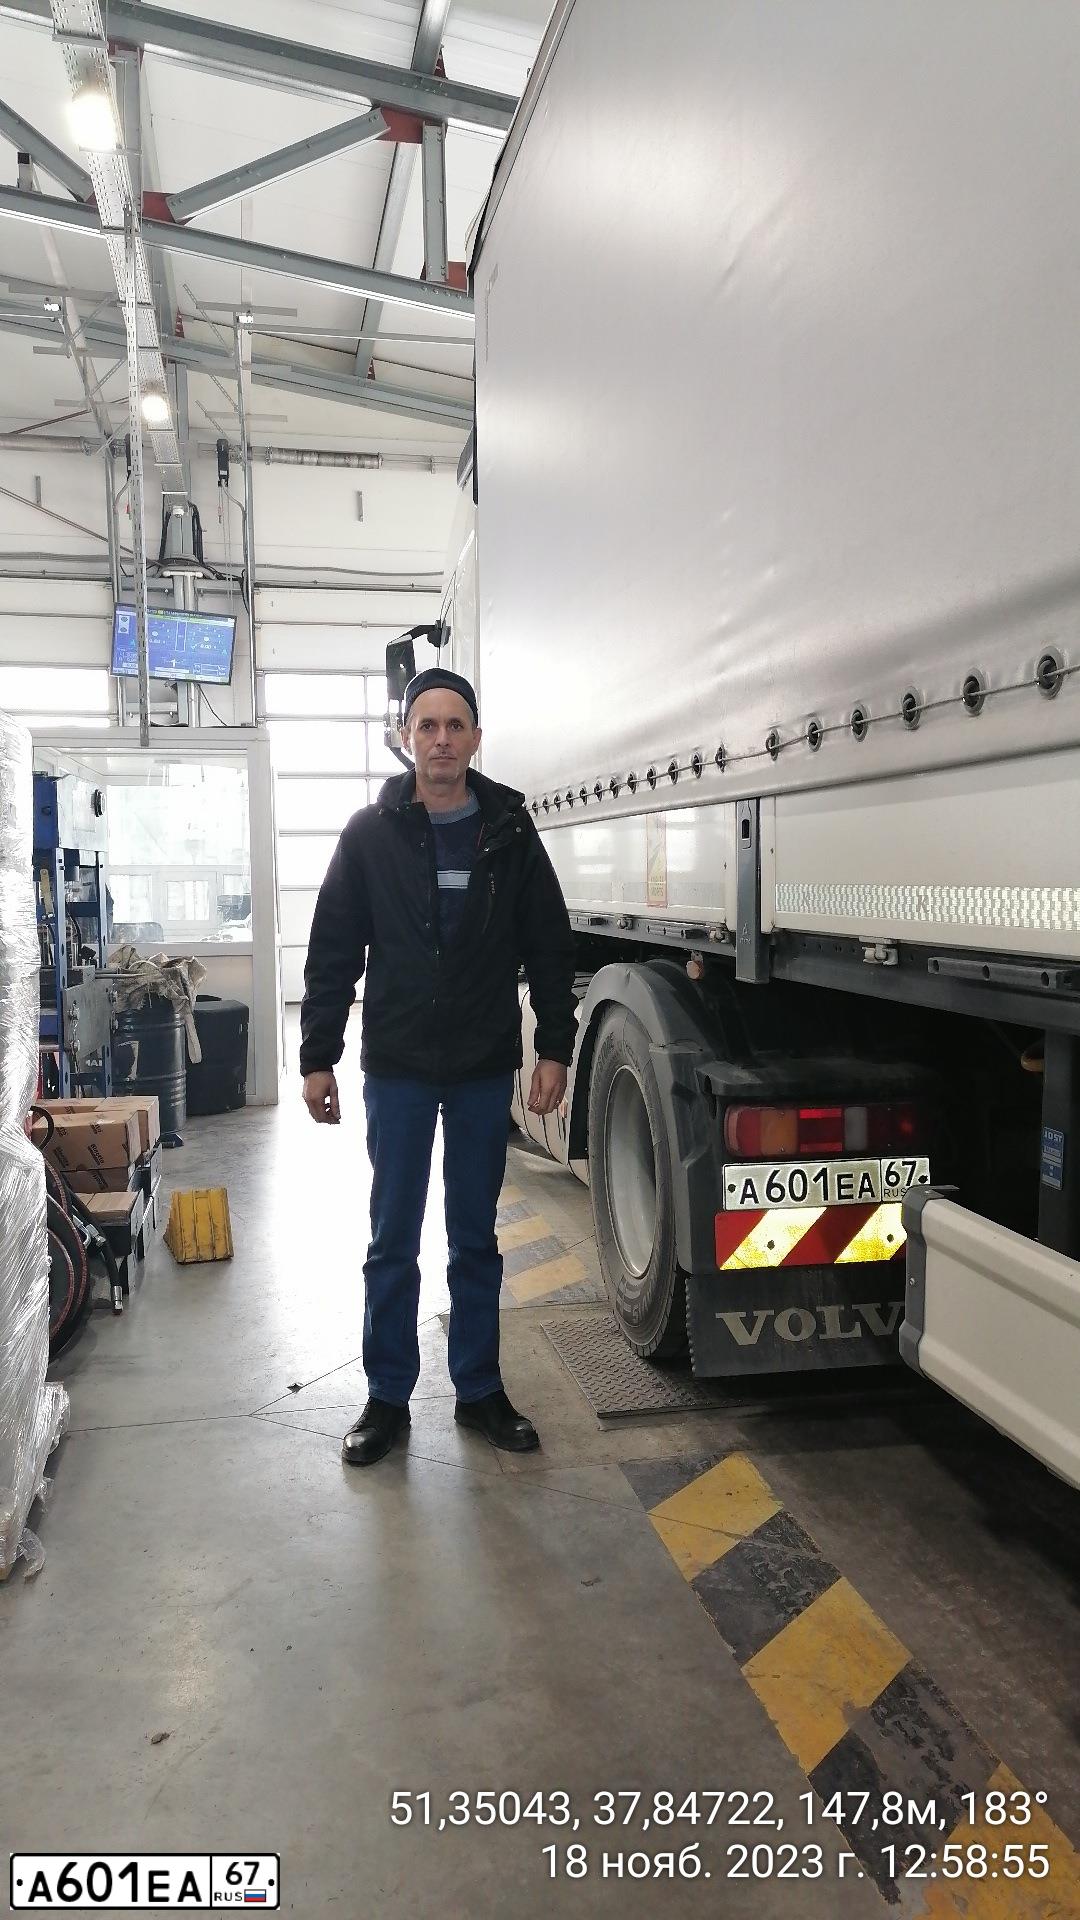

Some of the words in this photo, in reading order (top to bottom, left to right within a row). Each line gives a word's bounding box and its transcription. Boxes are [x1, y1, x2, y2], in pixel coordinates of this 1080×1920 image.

[1042, 1130, 1063, 1143] JOST
[739, 1167, 876, 1205] А601ЕА
[885, 1160, 917, 1187] 67
[883, 1188, 908, 1198] RUS
[715, 1302, 905, 1346] VOLV
